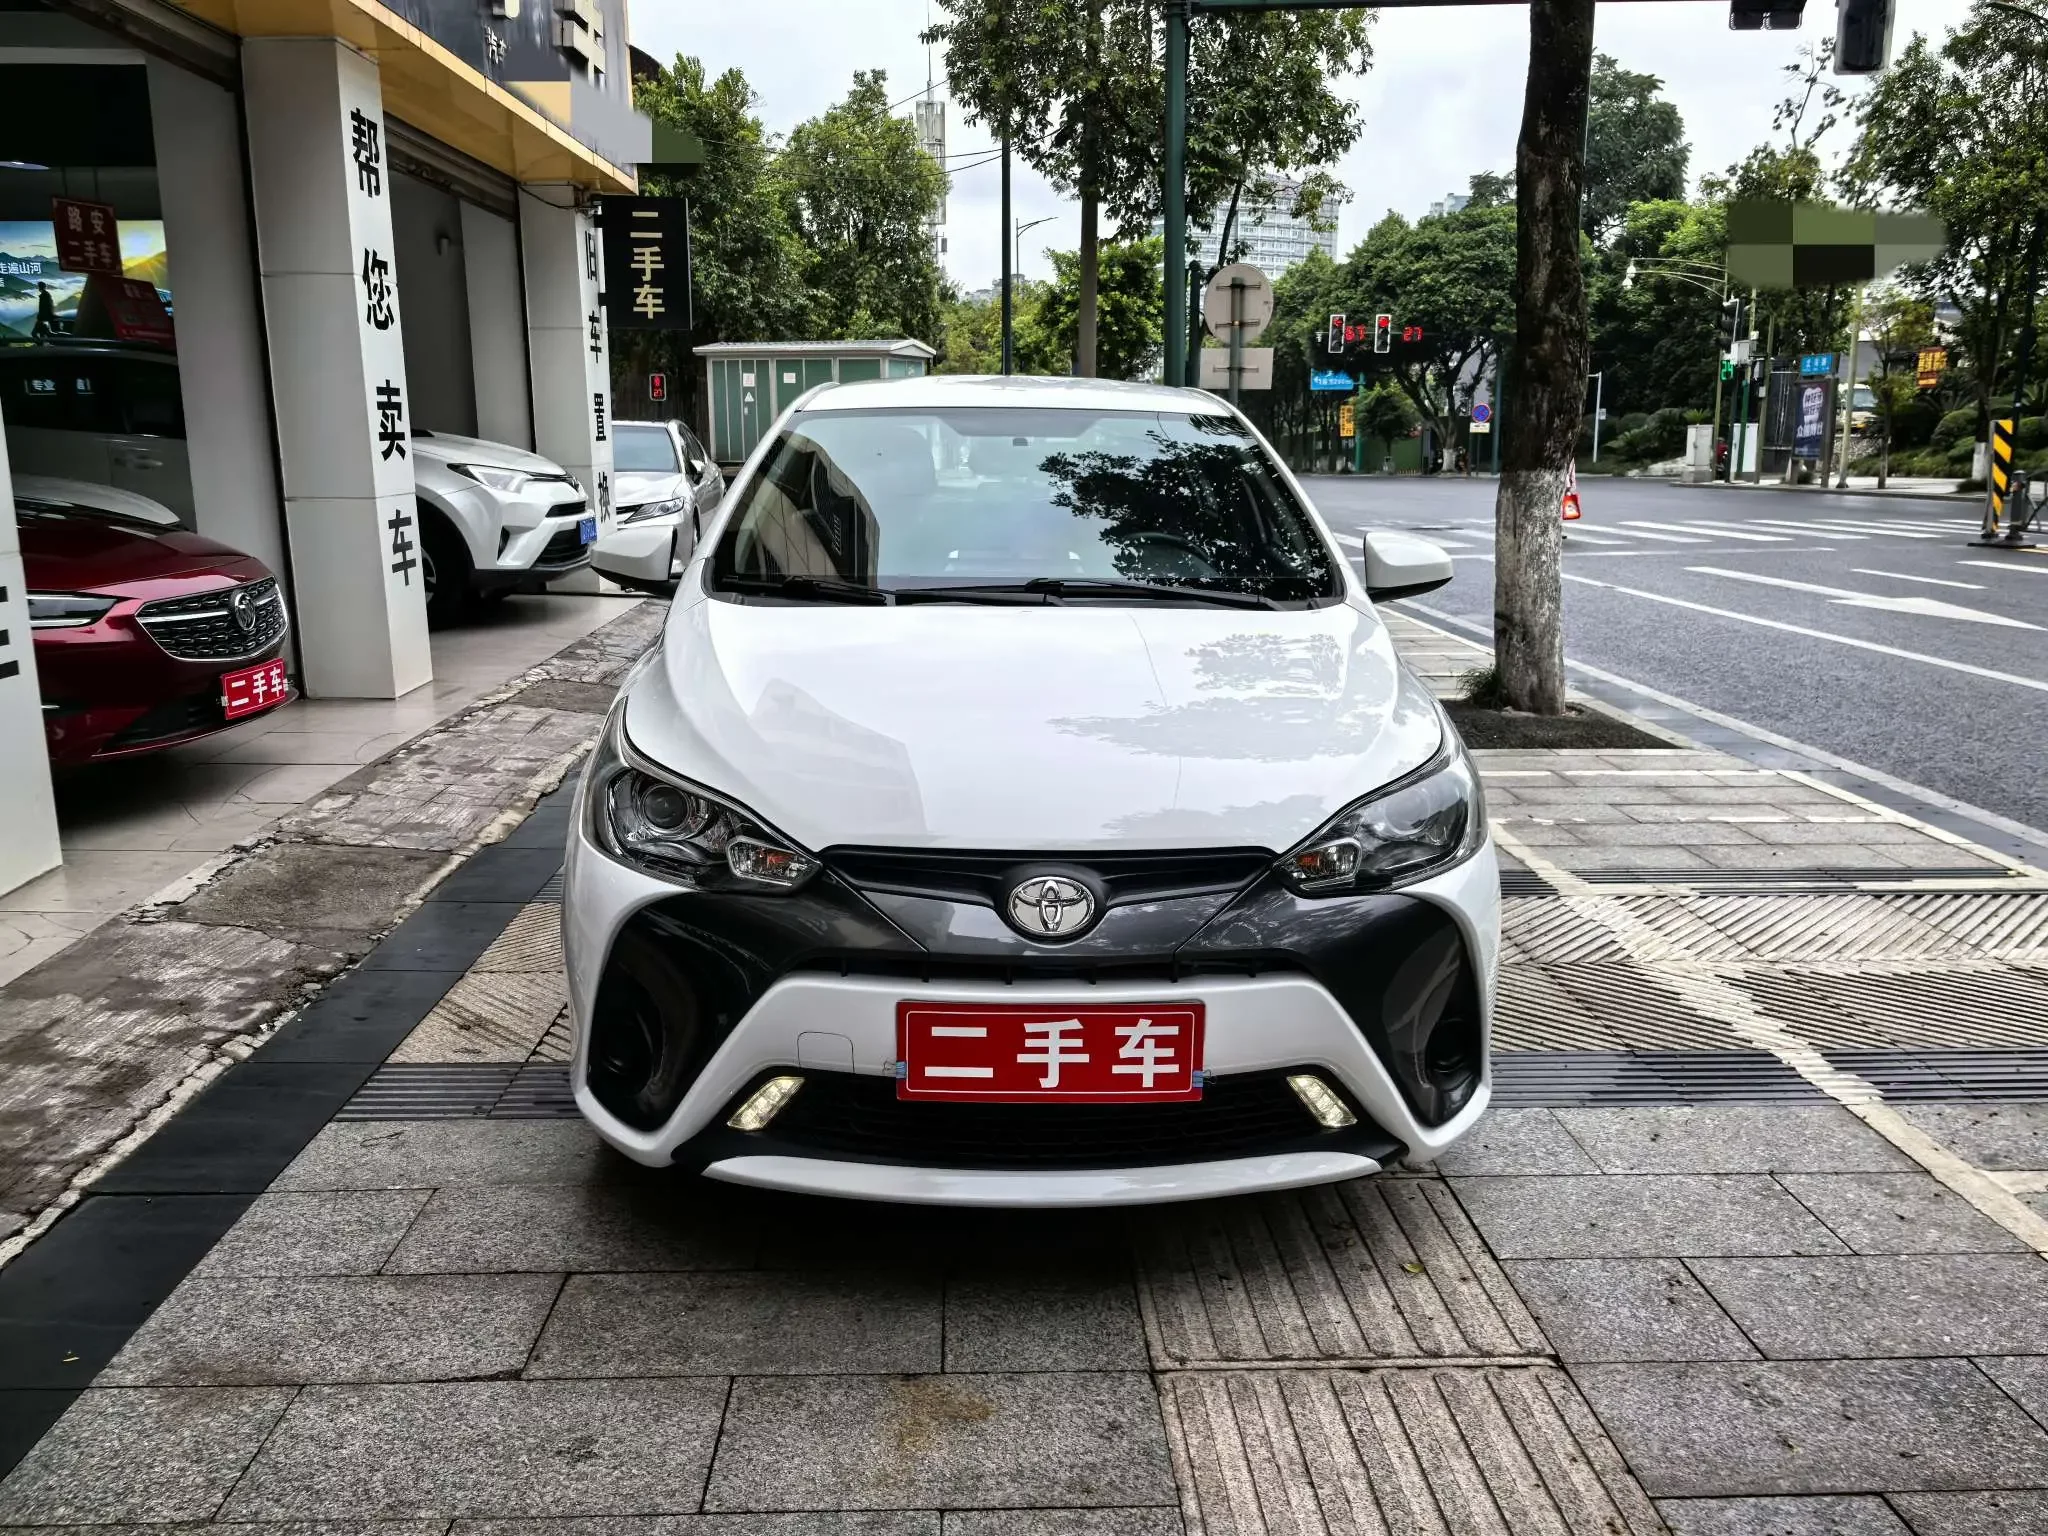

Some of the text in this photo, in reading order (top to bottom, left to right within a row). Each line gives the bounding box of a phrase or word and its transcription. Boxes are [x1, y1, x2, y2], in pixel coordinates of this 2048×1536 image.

[68, 240, 112, 267] 二手车
[630, 212, 665, 319] 二手车
[351, 107, 417, 586] 帮您卖车
[1403, 326, 1423, 342] 27
[585, 231, 610, 523] 旧车置换
[231, 667, 283, 706] 二手车
[925, 1018, 1180, 1089] 二手车
